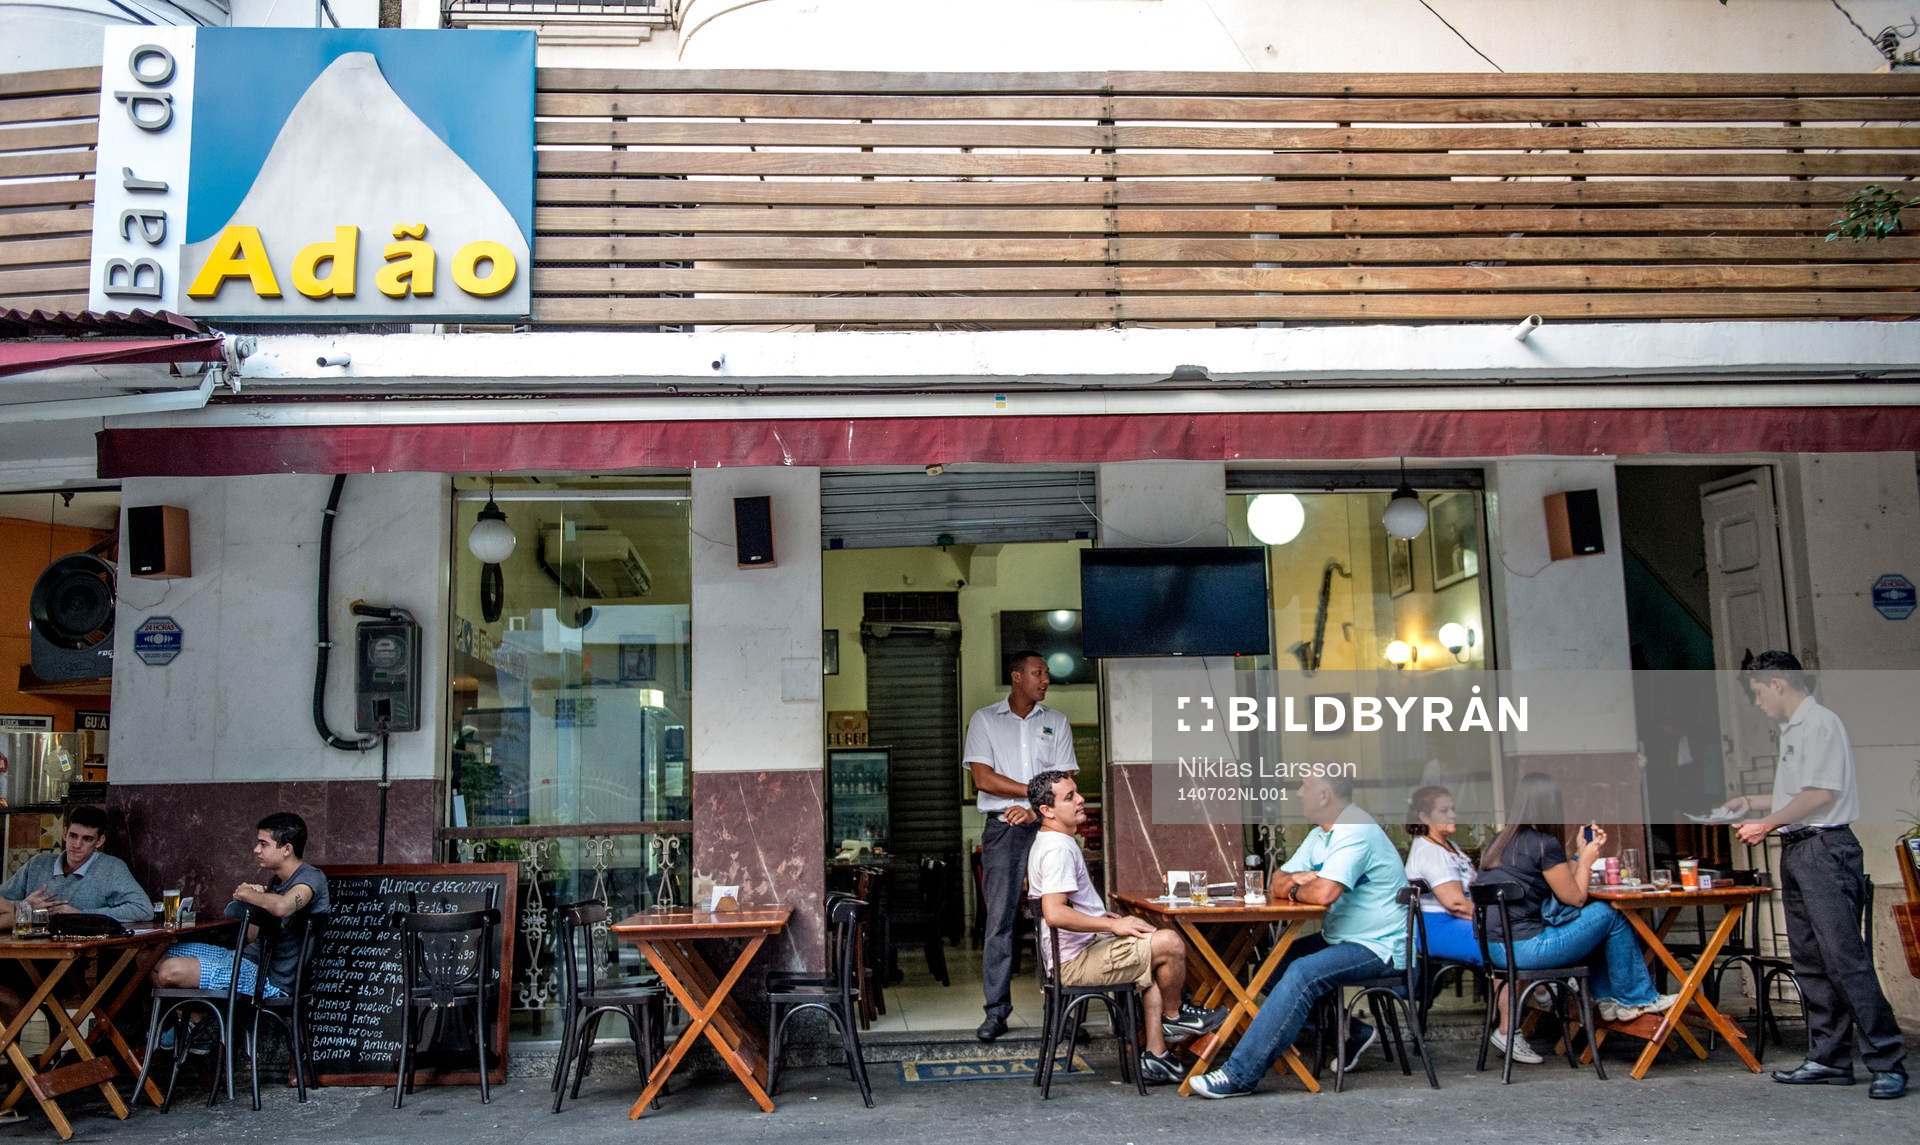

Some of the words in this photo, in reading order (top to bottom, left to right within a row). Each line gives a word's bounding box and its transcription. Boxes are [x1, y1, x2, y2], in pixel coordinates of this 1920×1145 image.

[114, 44, 176, 132] do
[103, 167, 169, 299] Bar
[187, 223, 517, 299] Adão
[312, 1035, 358, 1048] BANANA
